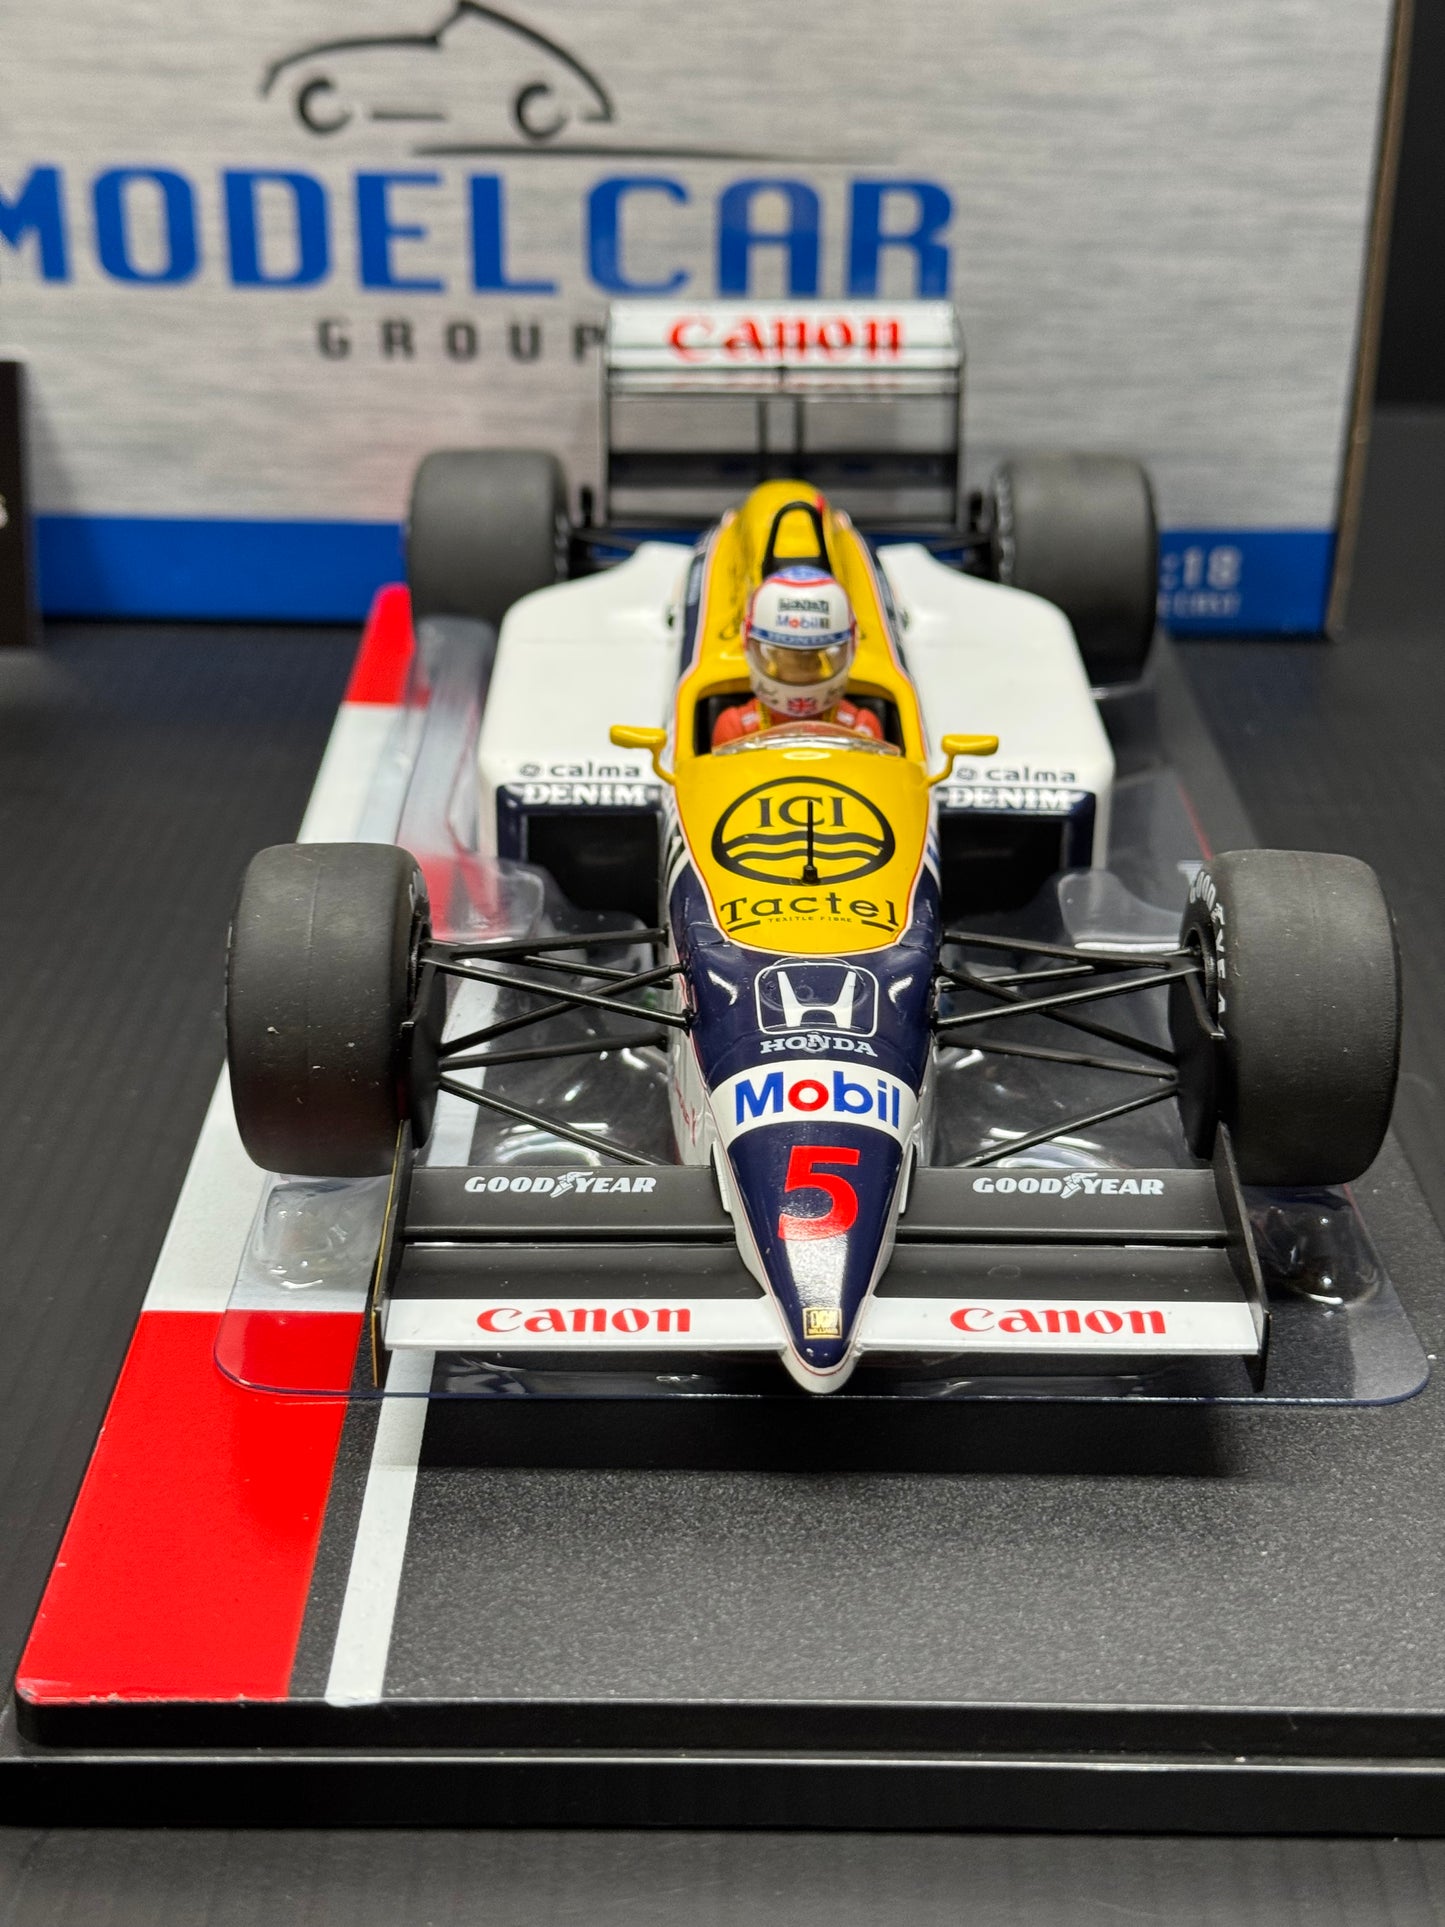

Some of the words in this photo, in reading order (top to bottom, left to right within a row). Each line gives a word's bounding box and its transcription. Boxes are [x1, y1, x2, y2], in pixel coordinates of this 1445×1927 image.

[317, 317, 606, 363] GROUP
[668, 318, 900, 361] Canon
[551, 761, 641, 778] calma
[985, 765, 1077, 783] calma
[522, 784, 648, 806] DENIM
[946, 787, 1075, 811] DENIM
[757, 795, 848, 828] ICI
[720, 892, 900, 926] Tactel
[760, 1032, 879, 1058] HONDA
[734, 1071, 900, 1130] Mobil
[777, 1145, 861, 1242] 5
[476, 1307, 691, 1333] Canon
[949, 1307, 1167, 1334] Canon
